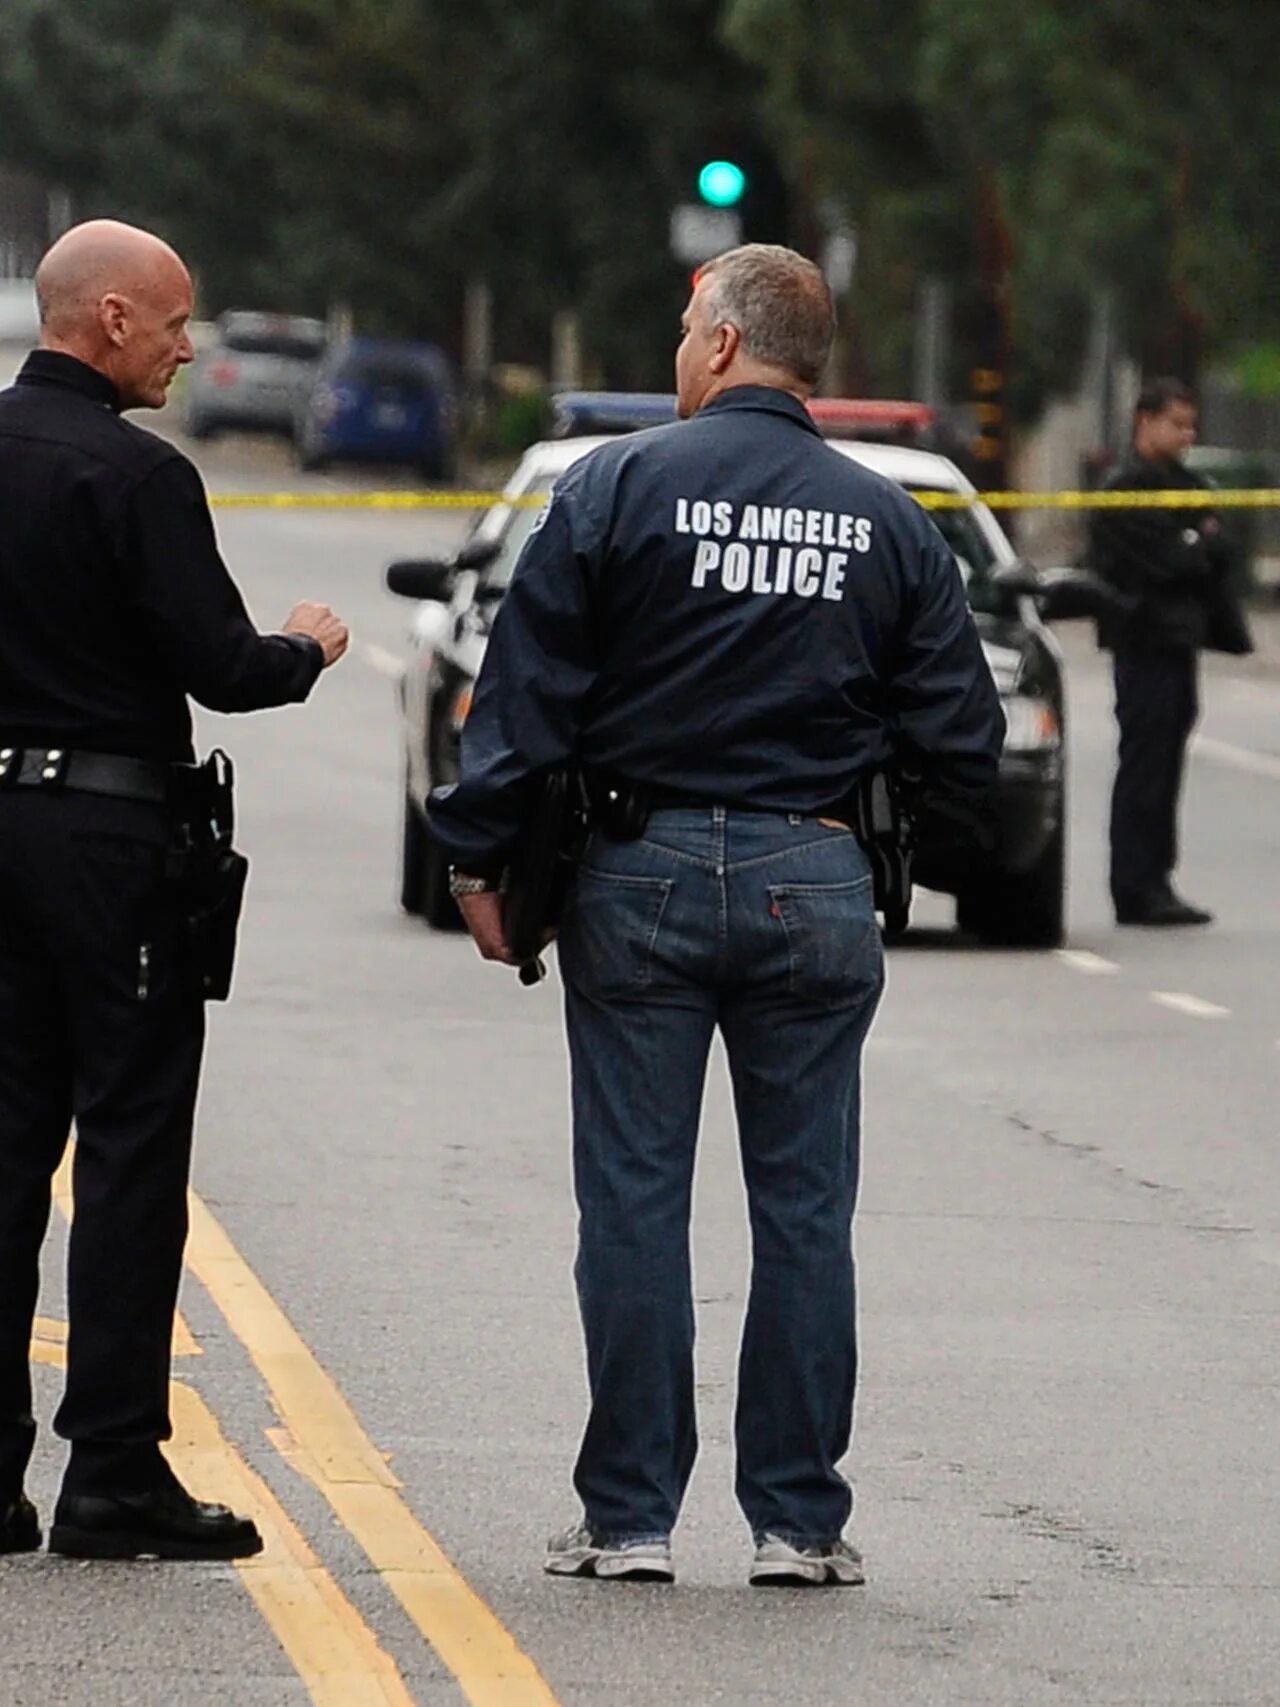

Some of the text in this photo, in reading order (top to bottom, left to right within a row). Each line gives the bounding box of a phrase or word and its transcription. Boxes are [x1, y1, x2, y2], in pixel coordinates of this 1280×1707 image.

[675, 498, 872, 553] LOS ANGELES
[691, 540, 849, 601] POLICE
